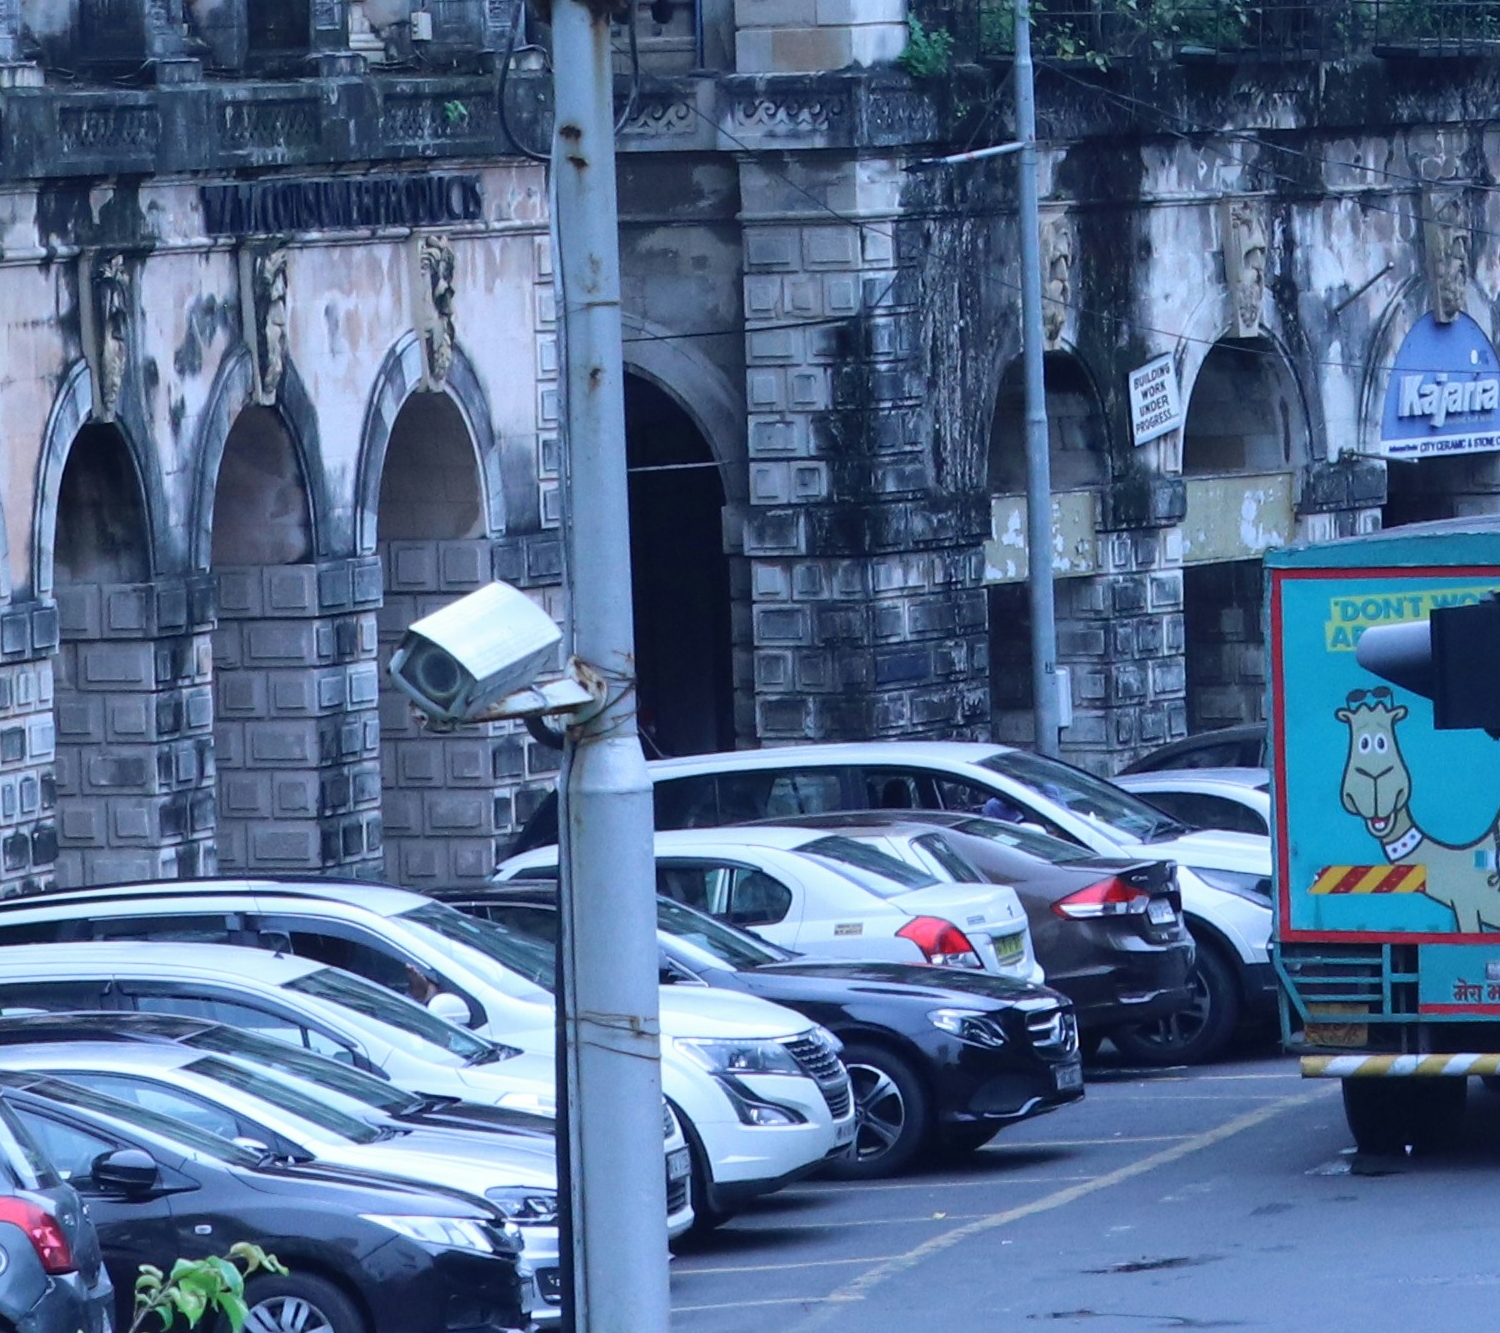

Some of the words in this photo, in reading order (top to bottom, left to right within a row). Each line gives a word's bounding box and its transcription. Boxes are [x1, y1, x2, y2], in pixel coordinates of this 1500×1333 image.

[1133, 361, 1170, 391] BUILDING
[1141, 379, 1167, 401] WORK
[1398, 373, 1500, 428] Kajaria
[1139, 394, 1170, 418] UNDER
[1420, 440, 1436, 453] CITY
